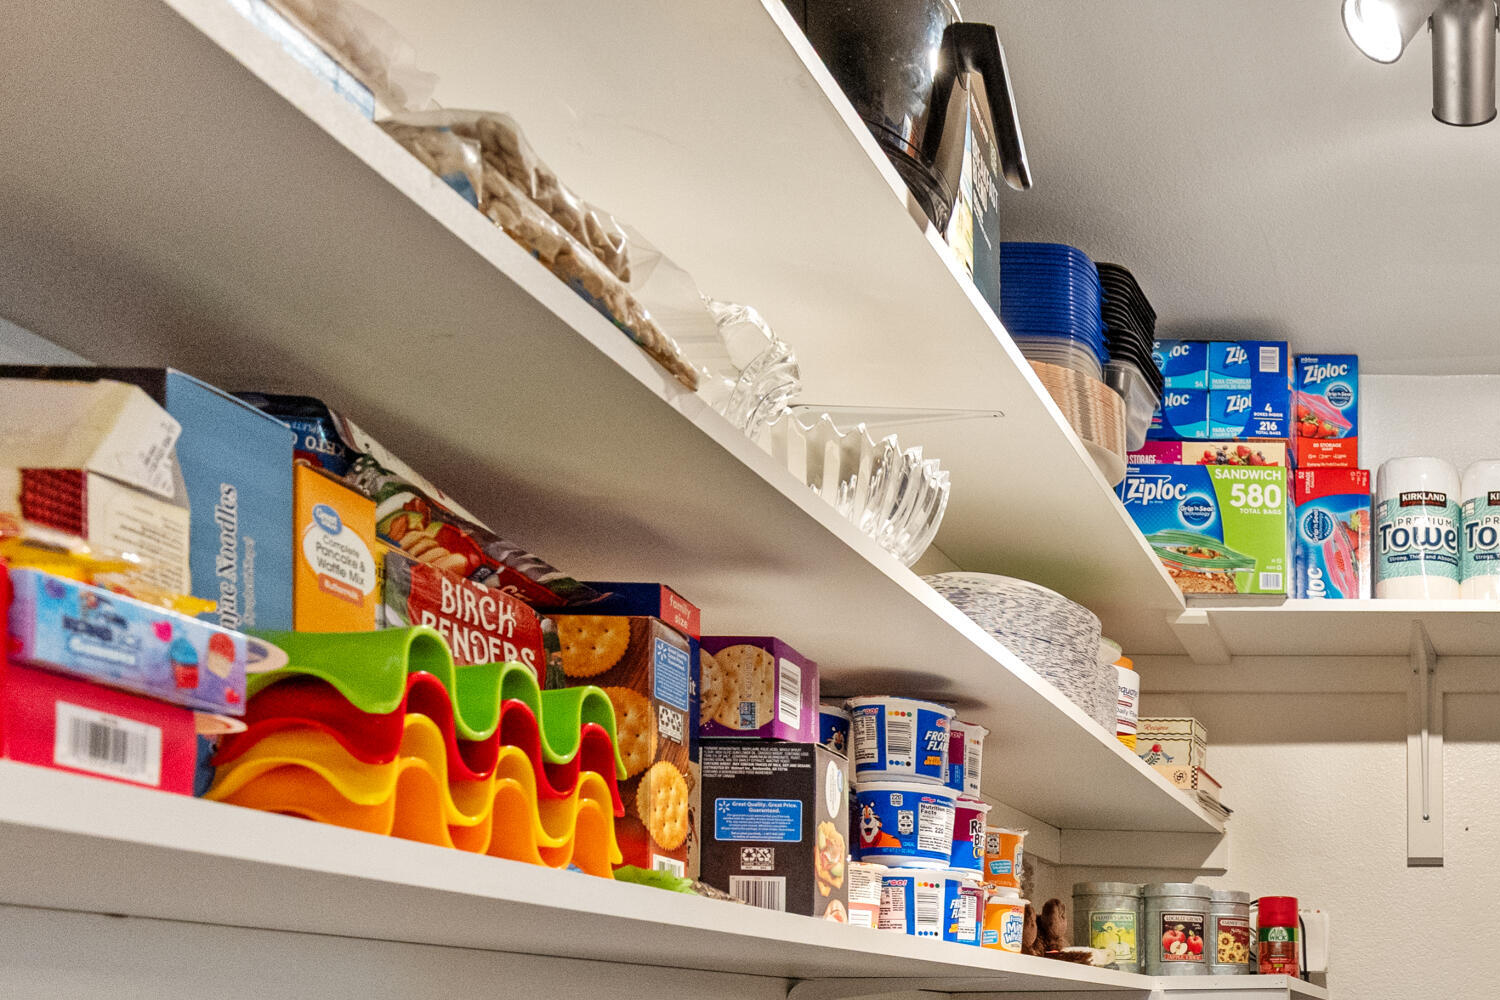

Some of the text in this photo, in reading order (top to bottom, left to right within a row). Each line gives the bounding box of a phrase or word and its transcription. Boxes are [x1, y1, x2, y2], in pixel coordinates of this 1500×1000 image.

[1303, 363, 1348, 383] Ziploc
[1264, 403, 1272, 413] 4
[1260, 422, 1277, 430] 216
[1129, 455, 1156, 464] STORAGE
[1215, 469, 1281, 480] SANDWICH
[1127, 479, 1187, 505] Ziploc
[1230, 484, 1281, 508] 580
[1402, 492, 1446, 502] KIRKLAND
[215, 483, 238, 583] Noodles
[316, 542, 358, 568] Pancake
[316, 556, 365, 586] Waffle Mix
[441, 576, 517, 638] BIRCH
[669, 595, 691, 620] family
[674, 614, 689, 631] size
[920, 804, 945, 812] Nutrition
